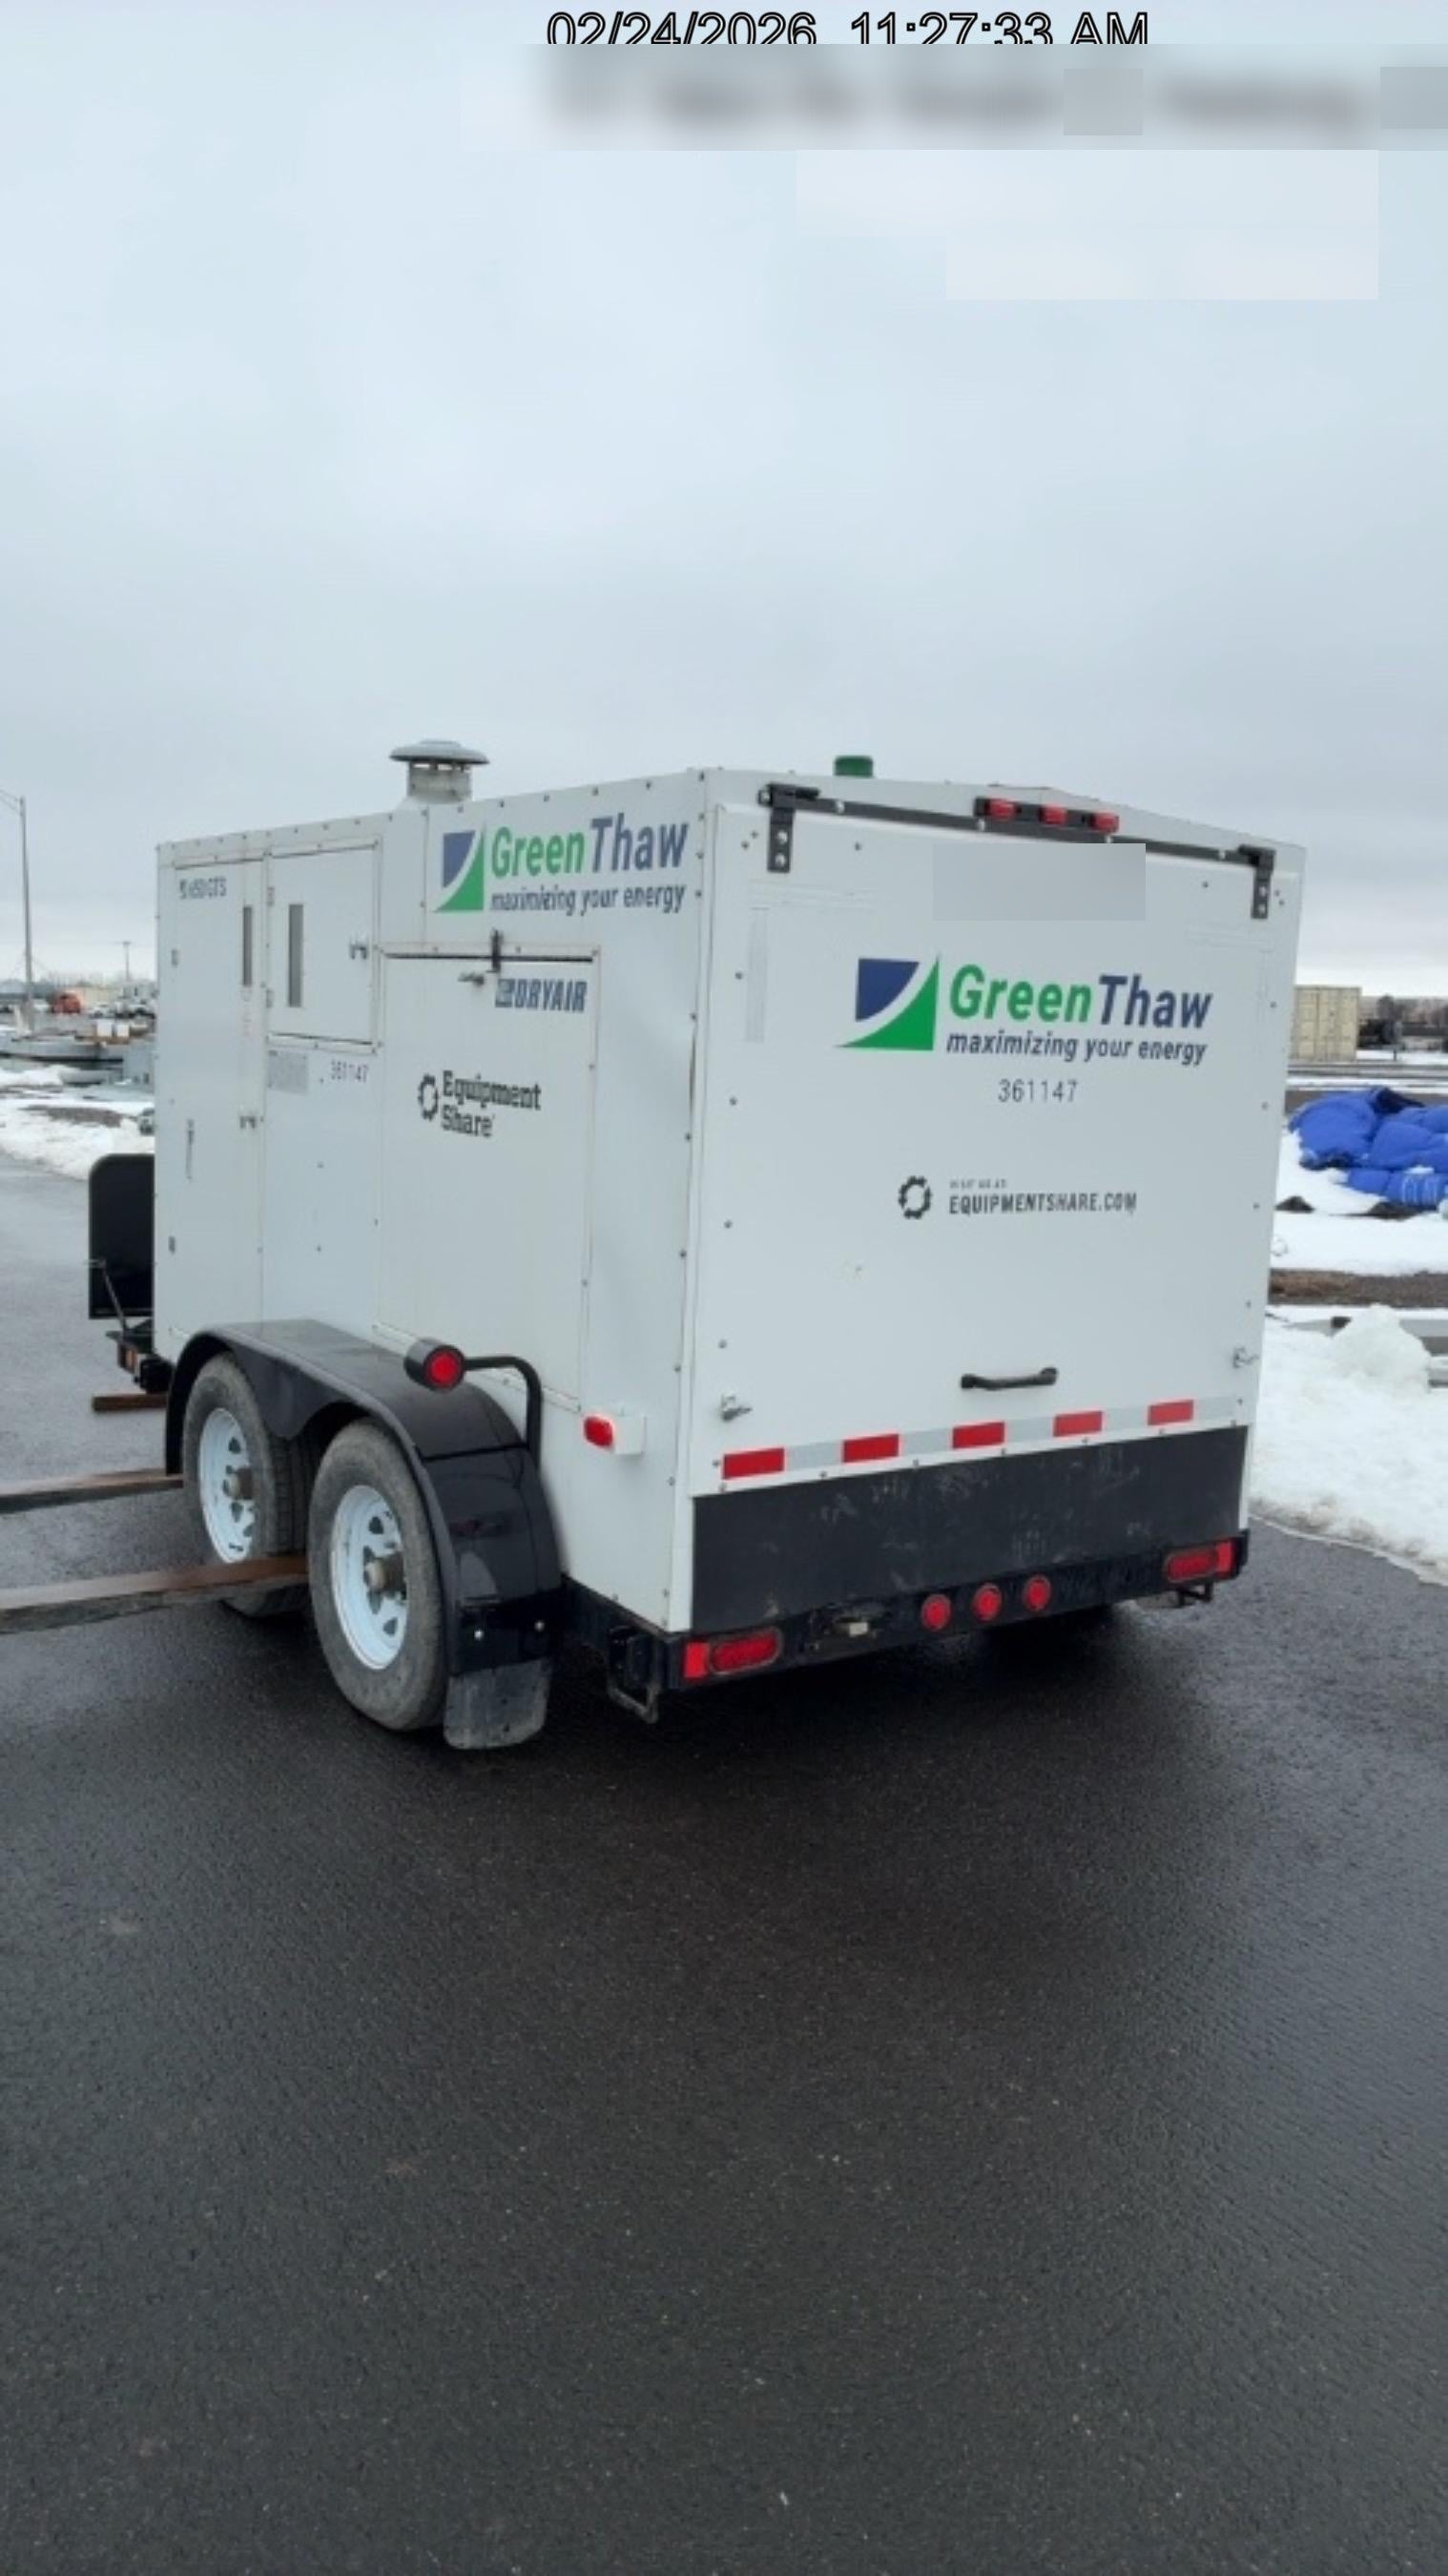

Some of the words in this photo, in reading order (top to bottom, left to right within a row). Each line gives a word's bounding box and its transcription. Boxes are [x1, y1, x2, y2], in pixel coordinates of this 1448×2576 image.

[490, 885, 576, 916] maximizing
[580, 890, 618, 916] your
[623, 883, 687, 914] energy
[515, 978, 588, 1013] DRYAIR
[946, 1030, 1079, 1062] maximizing
[1084, 1038, 1133, 1062] your
[1138, 1040, 1209, 1067] energy
[443, 1070, 541, 1111] Equipment
[998, 1078, 1078, 1103] 361147
[442, 1105, 493, 1137] Share
[949, 1193, 1137, 1216] EQUIPMENTSHARE.COM
